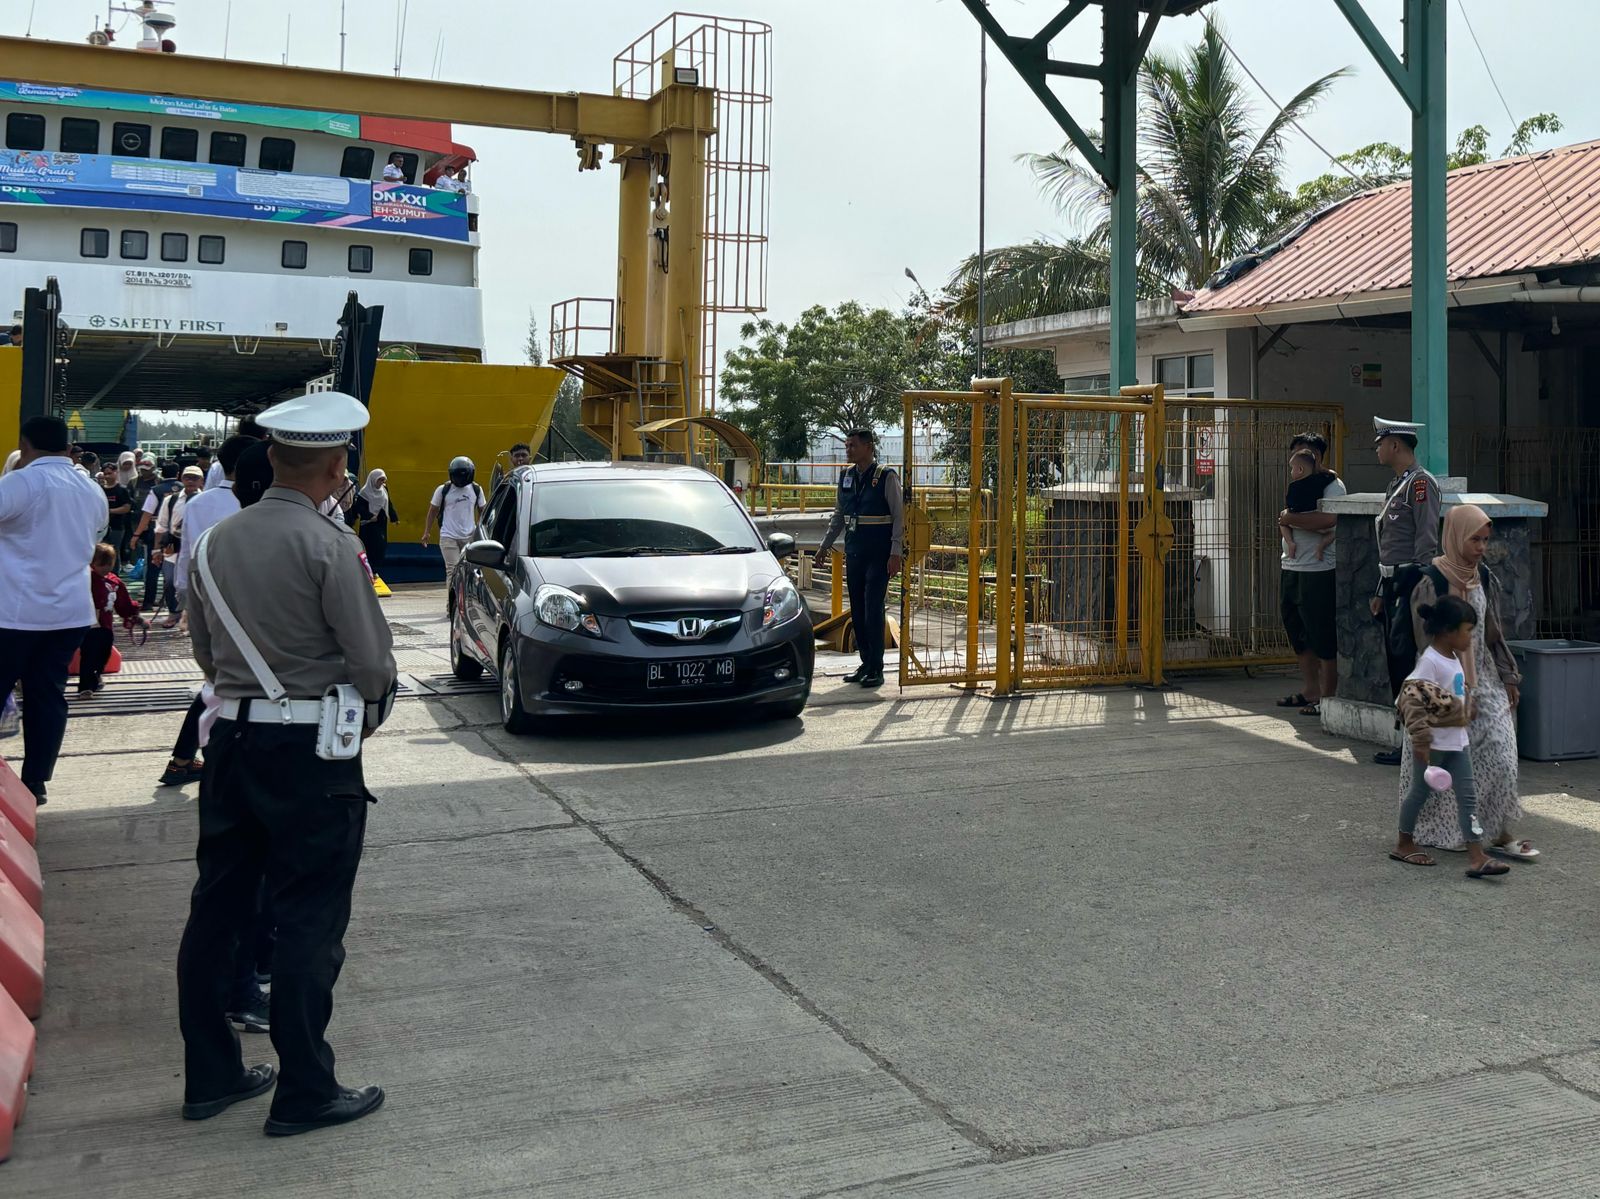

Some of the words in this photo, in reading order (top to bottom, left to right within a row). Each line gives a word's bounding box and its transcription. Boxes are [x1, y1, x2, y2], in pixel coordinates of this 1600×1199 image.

[0, 165, 37, 175] Mudik
[38, 166, 77, 176] Gratis
[400, 193, 426, 206] XXI
[373, 206, 426, 218] EH-SUMUT
[382, 215, 407, 223] 2024
[109, 316, 172, 330] SAFETY
[180, 320, 225, 332] FIRST
[650, 665, 665, 680] BL
[676, 662, 705, 678] 1022
[716, 660, 733, 675] MB
